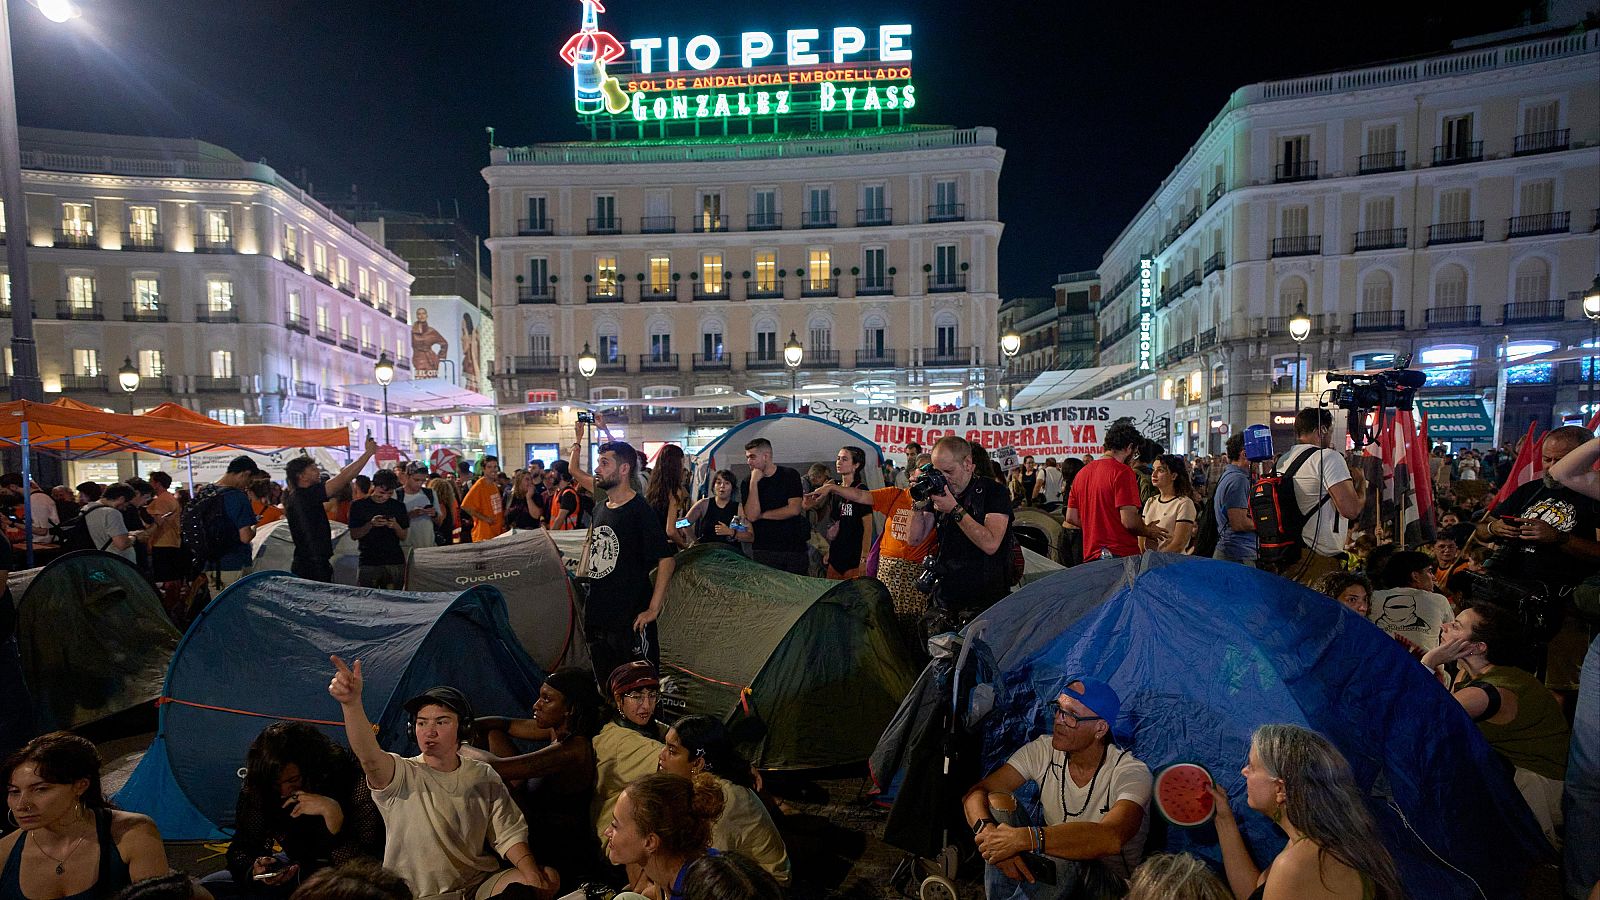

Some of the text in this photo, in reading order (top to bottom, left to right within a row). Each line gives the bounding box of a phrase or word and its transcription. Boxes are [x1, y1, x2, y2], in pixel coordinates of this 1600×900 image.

[630, 24, 912, 73] TIO PEPE
[628, 67, 911, 92] SOL DE ANDALUCIA EMBOTELLADO
[631, 81, 916, 121] GONZALEZ BYASS
[1140, 259, 1151, 307] HOTEL
[1140, 313, 1150, 370] EUROPA
[868, 406, 1110, 427] EXPROPIAR A LOS RENTISTAS
[1421, 400, 1477, 408] CHANGE
[965, 425, 1063, 449] GENERAL
[1069, 424, 1097, 443] YA
[1429, 424, 1487, 432] CAMBIO
[455, 569, 521, 585] Quechua
